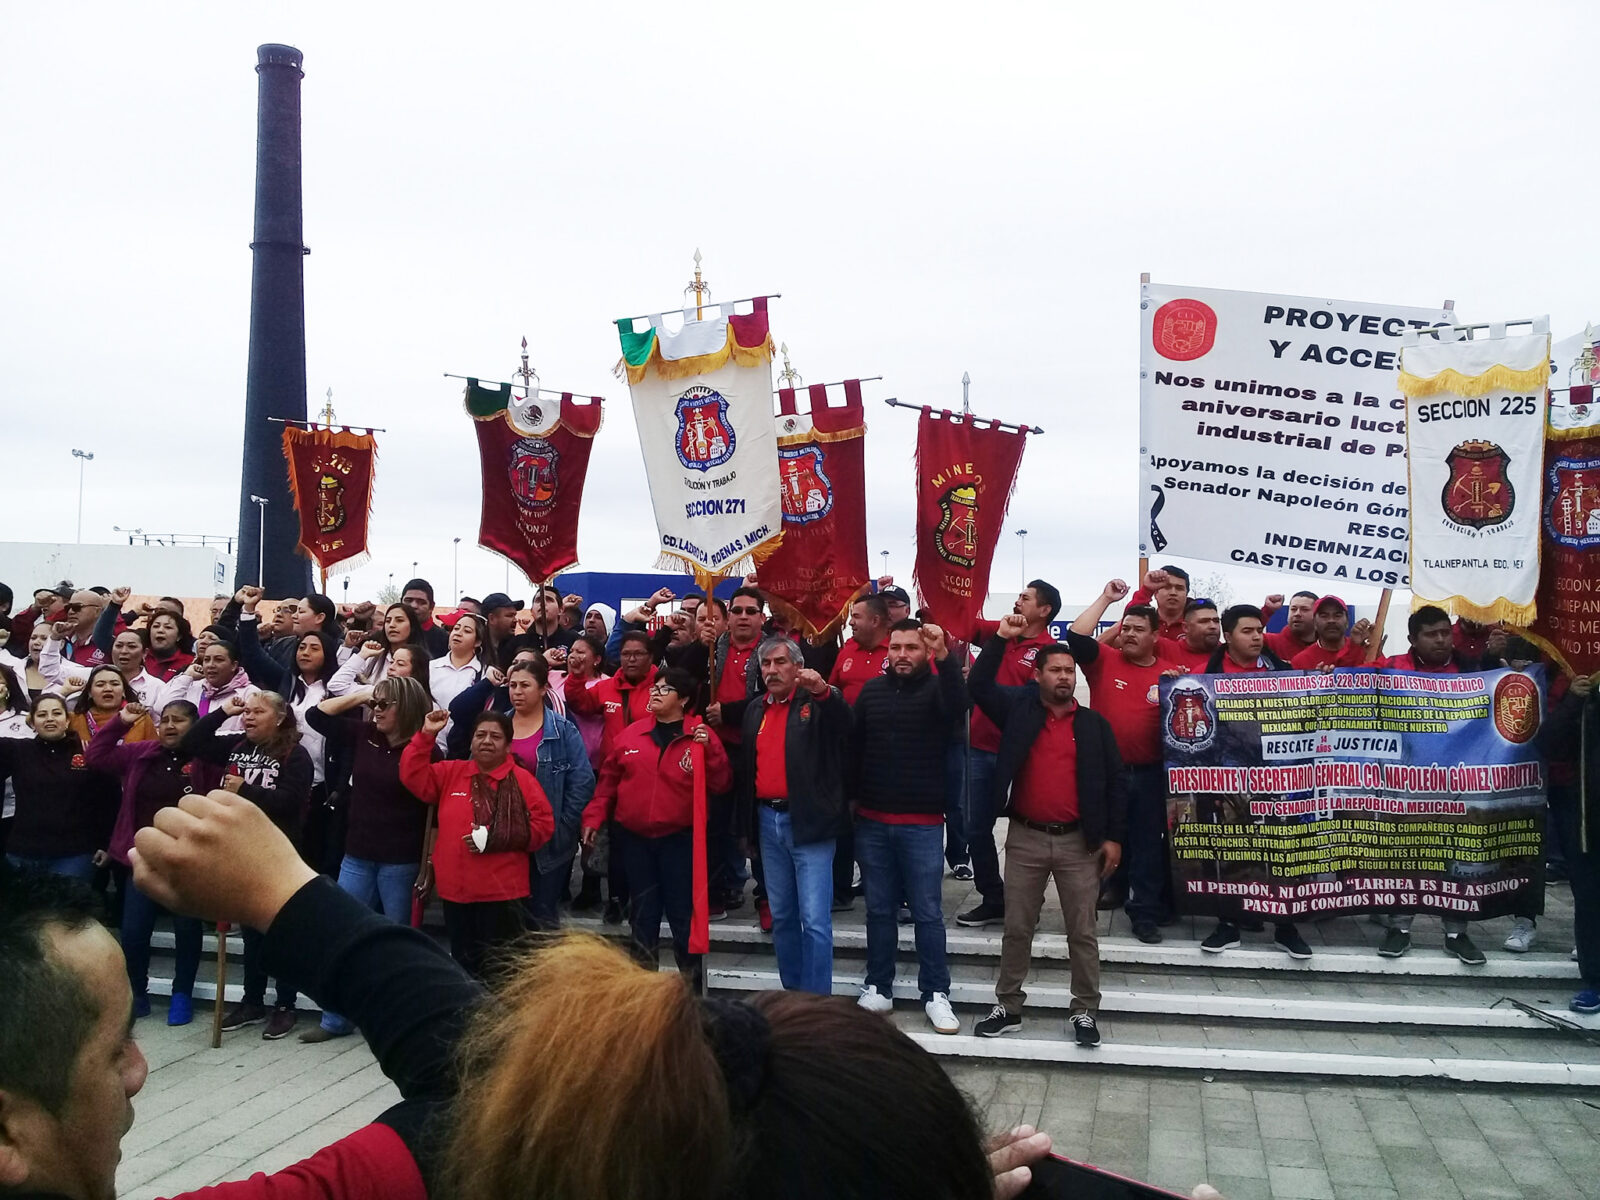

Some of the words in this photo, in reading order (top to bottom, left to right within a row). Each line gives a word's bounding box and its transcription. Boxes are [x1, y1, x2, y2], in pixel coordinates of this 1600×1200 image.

[1269, 339, 1291, 358] Y
[1155, 371, 1205, 388] Nos
[1215, 380, 1317, 400] unimos
[1326, 391, 1343, 404] a
[1353, 391, 1380, 407] la
[1182, 400, 1340, 427] aniversario
[1350, 415, 1406, 434] luct
[1418, 398, 1491, 423] SECCION
[1500, 396, 1536, 415] 225
[1197, 421, 1331, 450] industrial
[1341, 439, 1375, 455] de
[712, 470, 737, 488] TRABAJO
[1256, 466, 1275, 480] la
[1283, 470, 1374, 492] decisión
[1381, 482, 1407, 495] de
[1164, 477, 1250, 497] Senador
[1257, 488, 1359, 513] Napoleón
[725, 498, 745, 514] 271
[662, 534, 678, 548] CD.
[744, 524, 771, 545] MICH.
[1347, 522, 1409, 541] RESC
[1265, 532, 1409, 564] INDEMNIZACI
[1230, 549, 1328, 574] CASTIGO
[1334, 565, 1348, 577] A
[1355, 567, 1398, 585] LOS
[1423, 559, 1488, 569] TLALNEPANTLA
[1214, 679, 1230, 694] LAS
[1232, 677, 1277, 693] SECCIONES
[1279, 675, 1317, 692] MINERAS
[1355, 673, 1370, 689] 243
[1371, 674, 1377, 689] Y
[1378, 674, 1391, 689] 275
[1393, 675, 1408, 689] DEL
[1409, 676, 1437, 692] ESTADO
[1439, 678, 1449, 693] DE
[1450, 677, 1485, 693] MÉXICO
[1215, 699, 1254, 709] AFILIADOS
[1256, 699, 1262, 708] A
[1263, 697, 1299, 708] NUESTRO
[1300, 695, 1336, 706] GLORIOSO
[1337, 695, 1377, 704] SINDICATO
[1379, 695, 1417, 706] NACIONAL
[1418, 697, 1428, 706] DE
[1429, 696, 1490, 707] TRABAJADORES
[1373, 708, 1379, 717] Y
[1380, 708, 1422, 719] SIMILARES
[1423, 709, 1433, 719] DE
[1435, 709, 1444, 719] LA
[1445, 708, 1488, 720] REPÚBLICA
[1304, 721, 1317, 731] QUE
[1332, 720, 1381, 730] DIGNAMENTE
[1383, 721, 1408, 731] DIRIGE
[1409, 722, 1447, 732] NUESTRO
[1267, 739, 1315, 754] RESCATE
[1333, 737, 1398, 753] JUSTICIA
[1169, 766, 1239, 794] PRESIDENTE
[1239, 767, 1248, 793] Y
[1249, 764, 1314, 793] SECRETARIO
[1315, 762, 1362, 788] GENERAL
[1362, 764, 1383, 789] CO.
[1384, 763, 1447, 793] NAPOLEÓN
[1449, 762, 1491, 793] GÓMEZ
[1492, 761, 1543, 792] URRUTIA,
[1250, 801, 1273, 816] HOY
[1274, 799, 1317, 816] SENADOR
[1318, 798, 1328, 812] DE
[1329, 797, 1343, 811] LA
[1344, 796, 1404, 814] REPÚBLICA
[1406, 800, 1466, 815] MEXICANA
[1179, 824, 1222, 834] PRESENTES
[1224, 824, 1234, 834] EN
[1235, 825, 1243, 834] EL
[1259, 823, 1308, 835] ANIVERSARIO
[1308, 821, 1341, 833] LUCTUOSO
[1342, 819, 1352, 829] DE
[1353, 820, 1396, 833] NUESTROS
[1397, 822, 1455, 833] COMPAÑEROS
[1457, 823, 1488, 835] CAÍDOS
[1489, 823, 1498, 833] EN
[1499, 822, 1507, 832] LA
[1508, 820, 1527, 830] MINA
[1174, 837, 1198, 847] PASTA
[1199, 837, 1209, 847] DE
[1252, 838, 1300, 849] REITERAMOS
[1301, 835, 1329, 847] NUESTRO
[1329, 833, 1350, 844] TOTAL
[1351, 835, 1378, 845] APOYO
[1379, 835, 1444, 846] INCONDICIONAL
[1445, 836, 1451, 846] A
[1453, 837, 1482, 848] TODOS
[1483, 836, 1497, 847] SUS
[1498, 832, 1541, 845] FAMILIARES
[1176, 850, 1182, 859] Y
[1223, 850, 1262, 861] EXIGIMOS
[1270, 852, 1285, 863] LAS
[1286, 849, 1330, 863] AUTORIDADES
[1330, 846, 1408, 859] CORRESPONDIENTES
[1409, 848, 1418, 858] EL
[1419, 849, 1453, 859] PRONTO
[1455, 850, 1489, 862] RESCATE
[1499, 846, 1539, 858] NUESTROS
[1272, 866, 1282, 876] 63
[1284, 863, 1329, 877] COMPAÑEROS
[1330, 862, 1342, 872] QUE
[1342, 858, 1357, 871] AÚN
[1358, 860, 1388, 870] SIGUEN
[1390, 860, 1400, 870] EN
[1402, 860, 1416, 870] ESE
[1417, 861, 1447, 872] LUGAR.
[1187, 881, 1203, 893] NI
[1207, 881, 1274, 898] PERDÓN,
[1279, 886, 1294, 899] NI
[1297, 881, 1343, 897] OLVIDO
[1420, 879, 1437, 891] ES
[1442, 881, 1460, 895] EL
[1243, 898, 1288, 915] PASTA
[1291, 900, 1308, 914] DE
[1310, 895, 1370, 911] CONCHOS
[1374, 893, 1396, 906] NO
[1400, 893, 1417, 905] SE
[1423, 894, 1480, 912] OLVIDA
